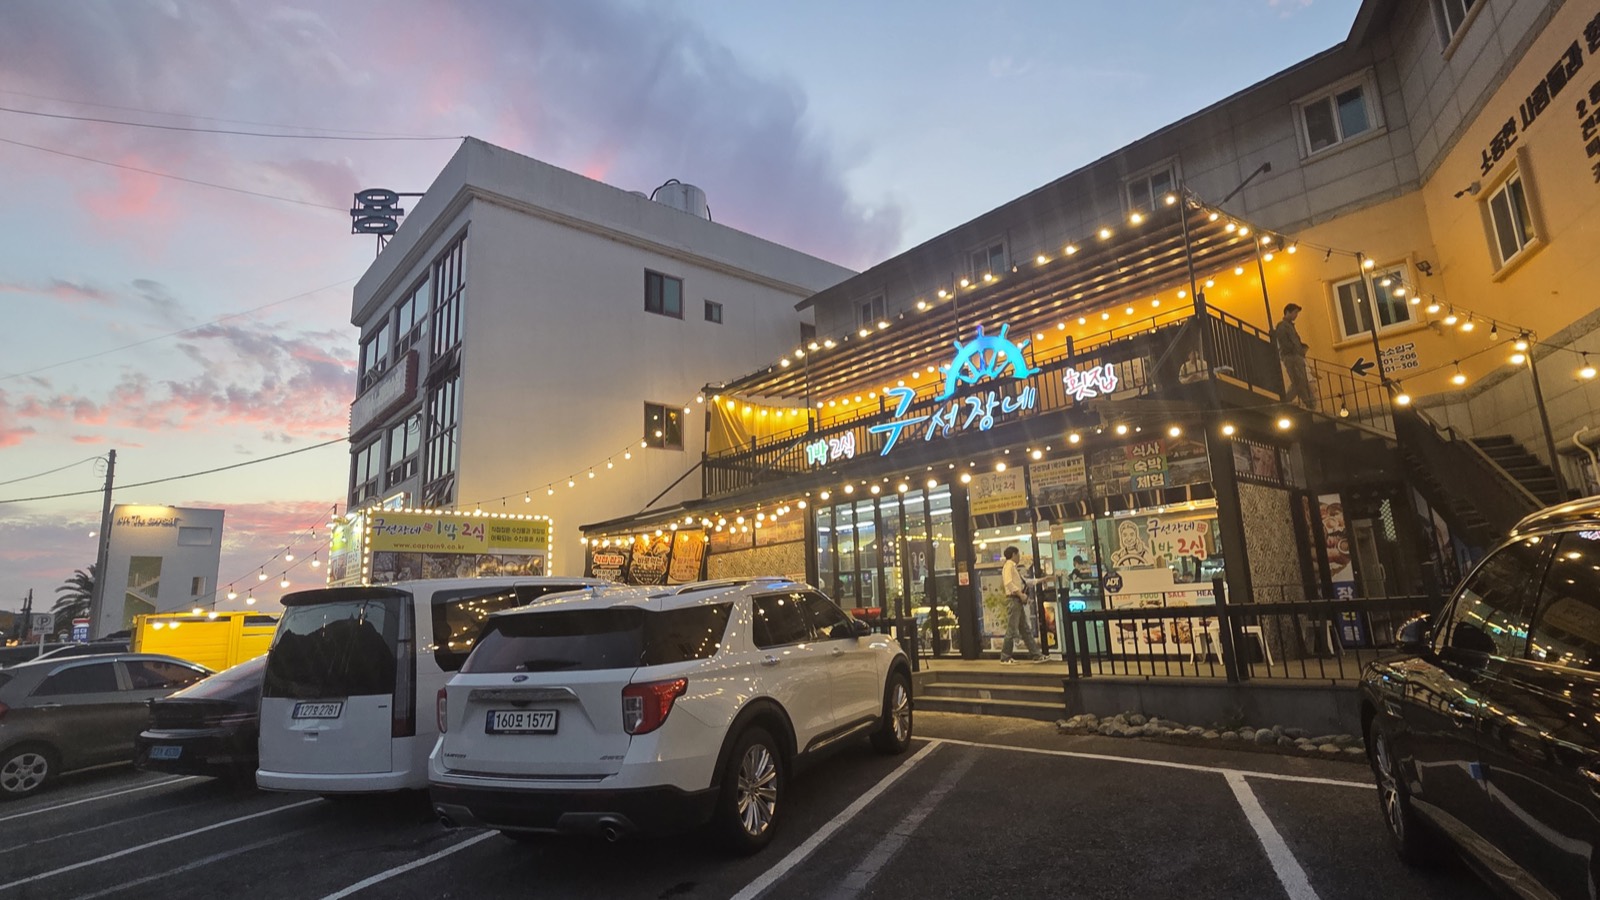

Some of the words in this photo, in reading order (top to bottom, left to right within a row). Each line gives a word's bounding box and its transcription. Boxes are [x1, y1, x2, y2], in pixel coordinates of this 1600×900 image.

[1481, 117, 1518, 177] 소중한
[1519, 39, 1583, 132] 사람들과
[806, 439, 827, 465] 1박
[830, 431, 855, 459] 2식
[868, 386, 1037, 457] 구선장네
[1063, 362, 1118, 400] 횟집
[1132, 441, 1160, 457] 식사
[1134, 457, 1162, 472] 숙박
[1136, 473, 1165, 488] 체험
[373, 518, 421, 536] 구선장네
[437, 520, 458, 541] 1박
[461, 523, 485, 542] 2식
[1148, 519, 1195, 538] 구선장네
[1151, 539, 1173, 561] 1박
[1177, 535, 1204, 559] 2식
[1105, 576, 1119, 586] ADT
[319, 704, 339, 716] 2781
[527, 713, 554, 728] 1577
